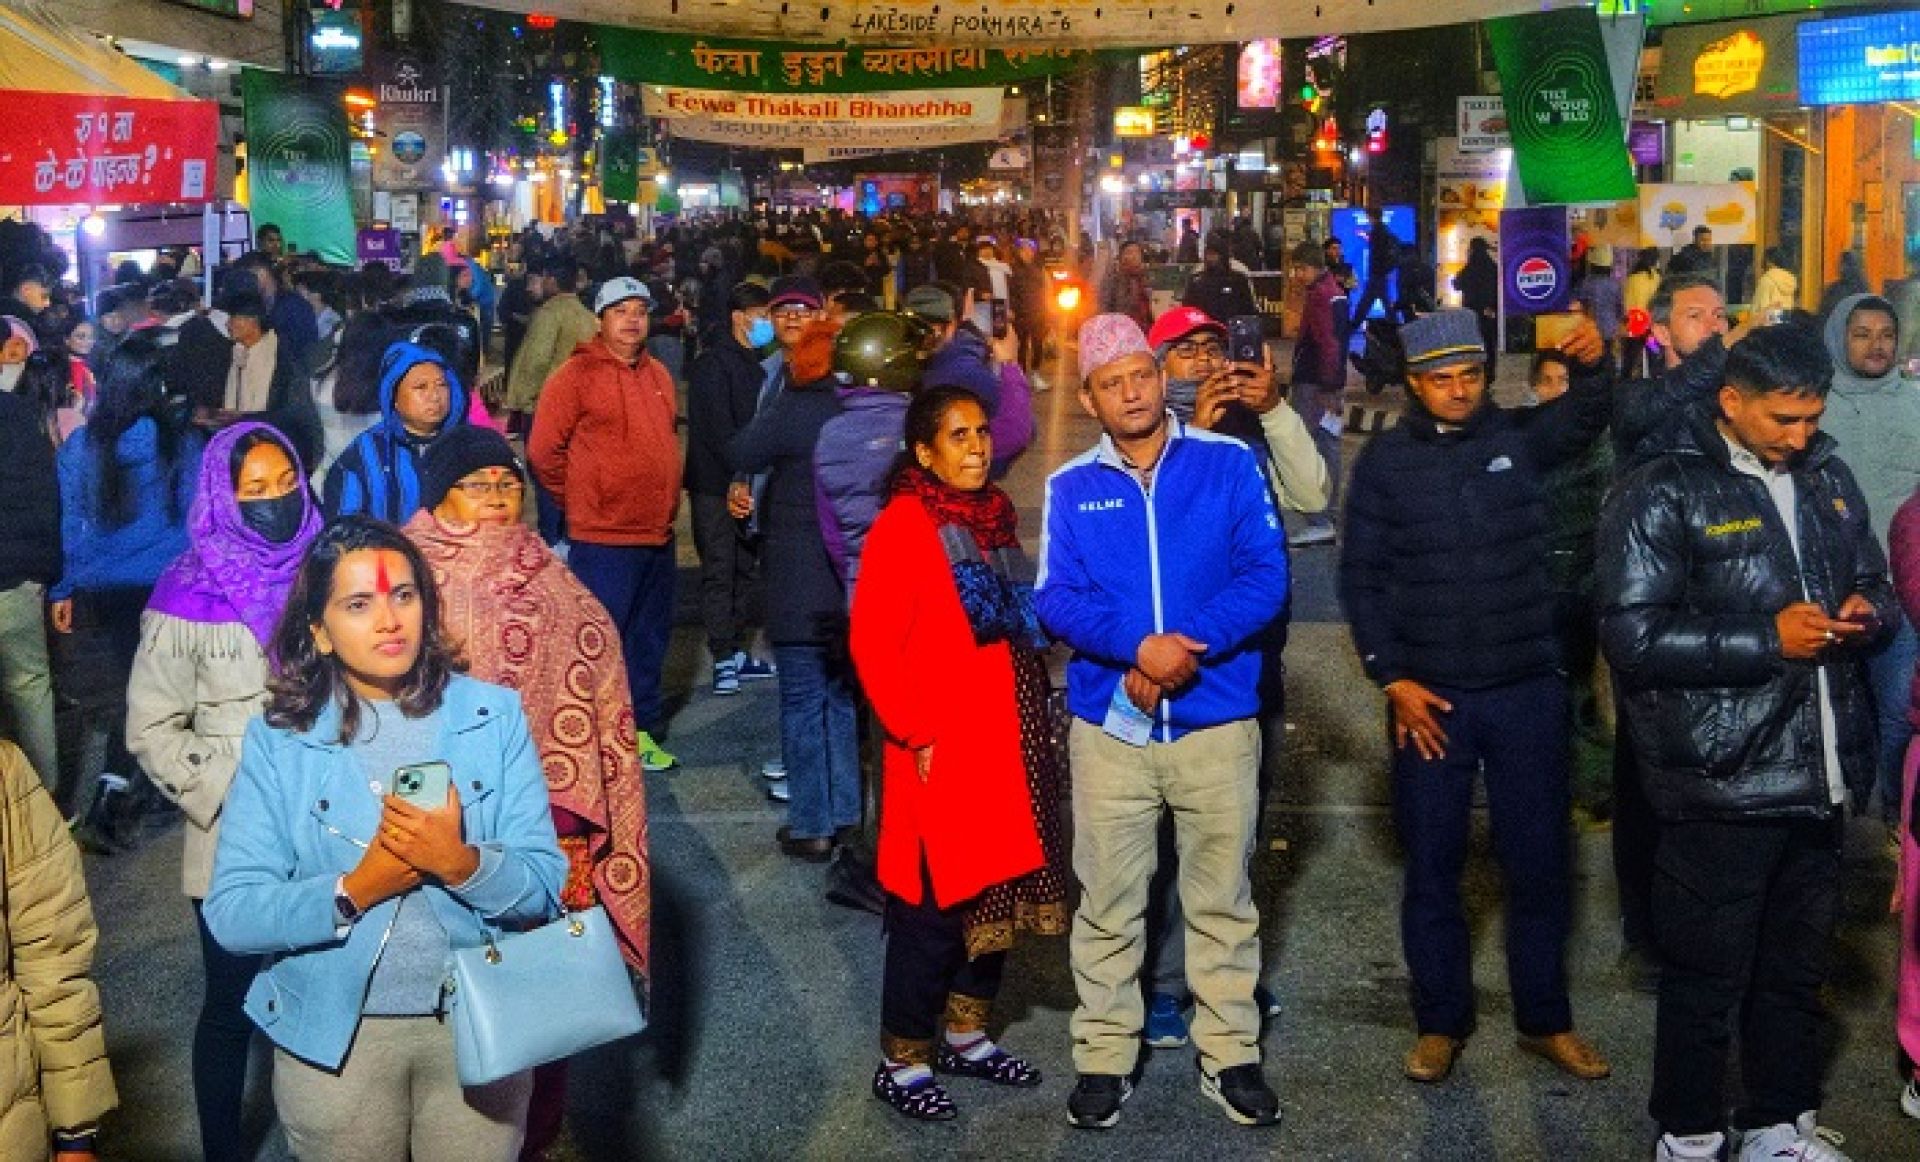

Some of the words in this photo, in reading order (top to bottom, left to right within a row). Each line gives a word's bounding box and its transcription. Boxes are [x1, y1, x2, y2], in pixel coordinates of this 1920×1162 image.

[380, 84, 437, 102] Khukri
[745, 98, 838, 118] Thakali
[849, 99, 972, 119] Bhanchha
